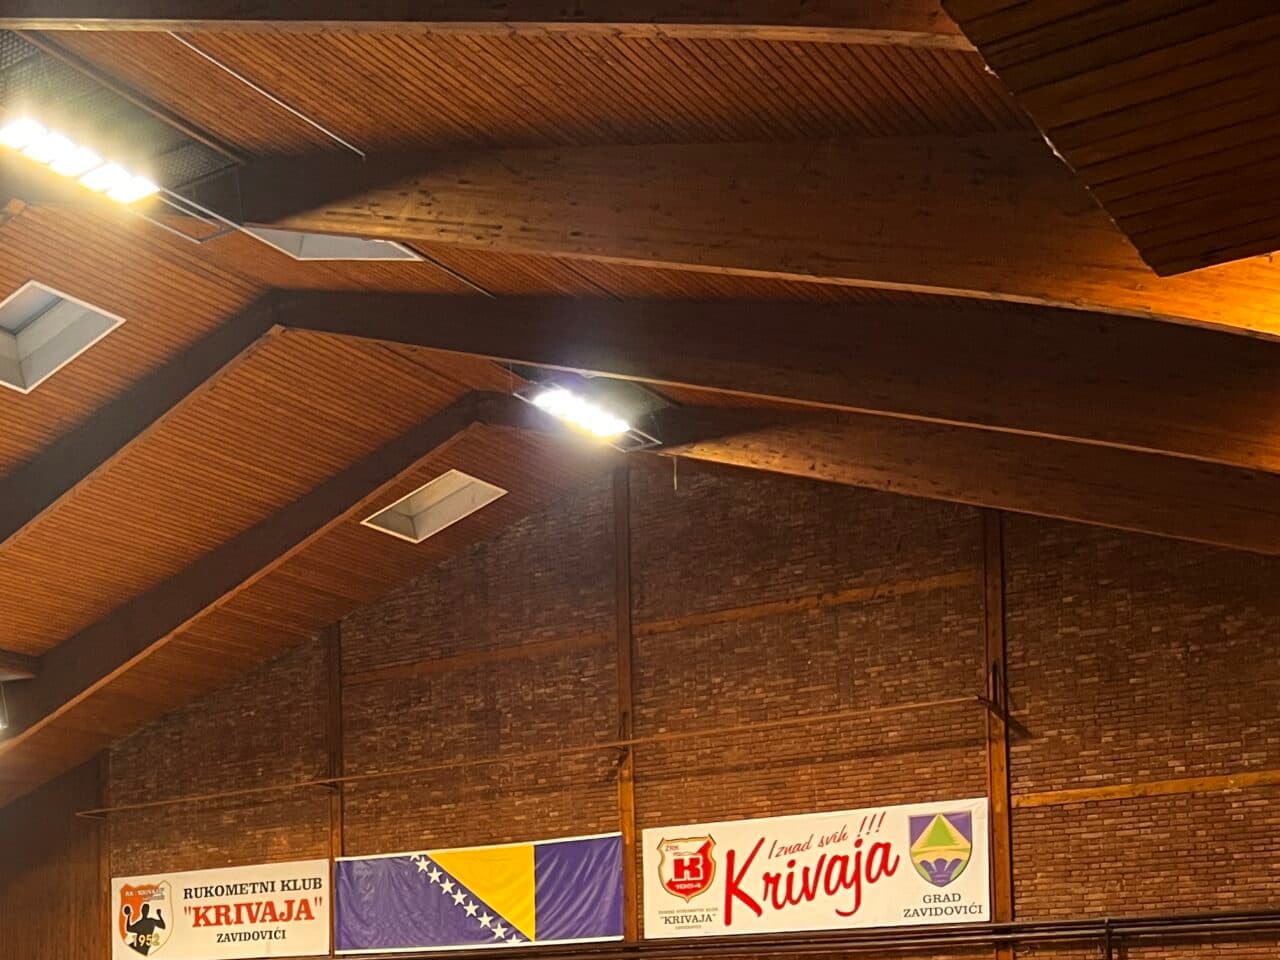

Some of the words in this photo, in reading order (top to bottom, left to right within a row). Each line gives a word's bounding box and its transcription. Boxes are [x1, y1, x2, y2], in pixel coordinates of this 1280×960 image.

[768, 830, 811, 860] Iznad
[817, 824, 848, 848] svih
[184, 881, 276, 899] RUKOMETNI
[280, 877, 322, 891] KLUB
[724, 837, 900, 926] Krivaja
[922, 893, 962, 904] GRAD
[184, 897, 322, 927] "KRIVAJA"
[903, 903, 983, 917] ZAVIDOVIĆI
[216, 927, 286, 943] ZAVIDOVIĆI
